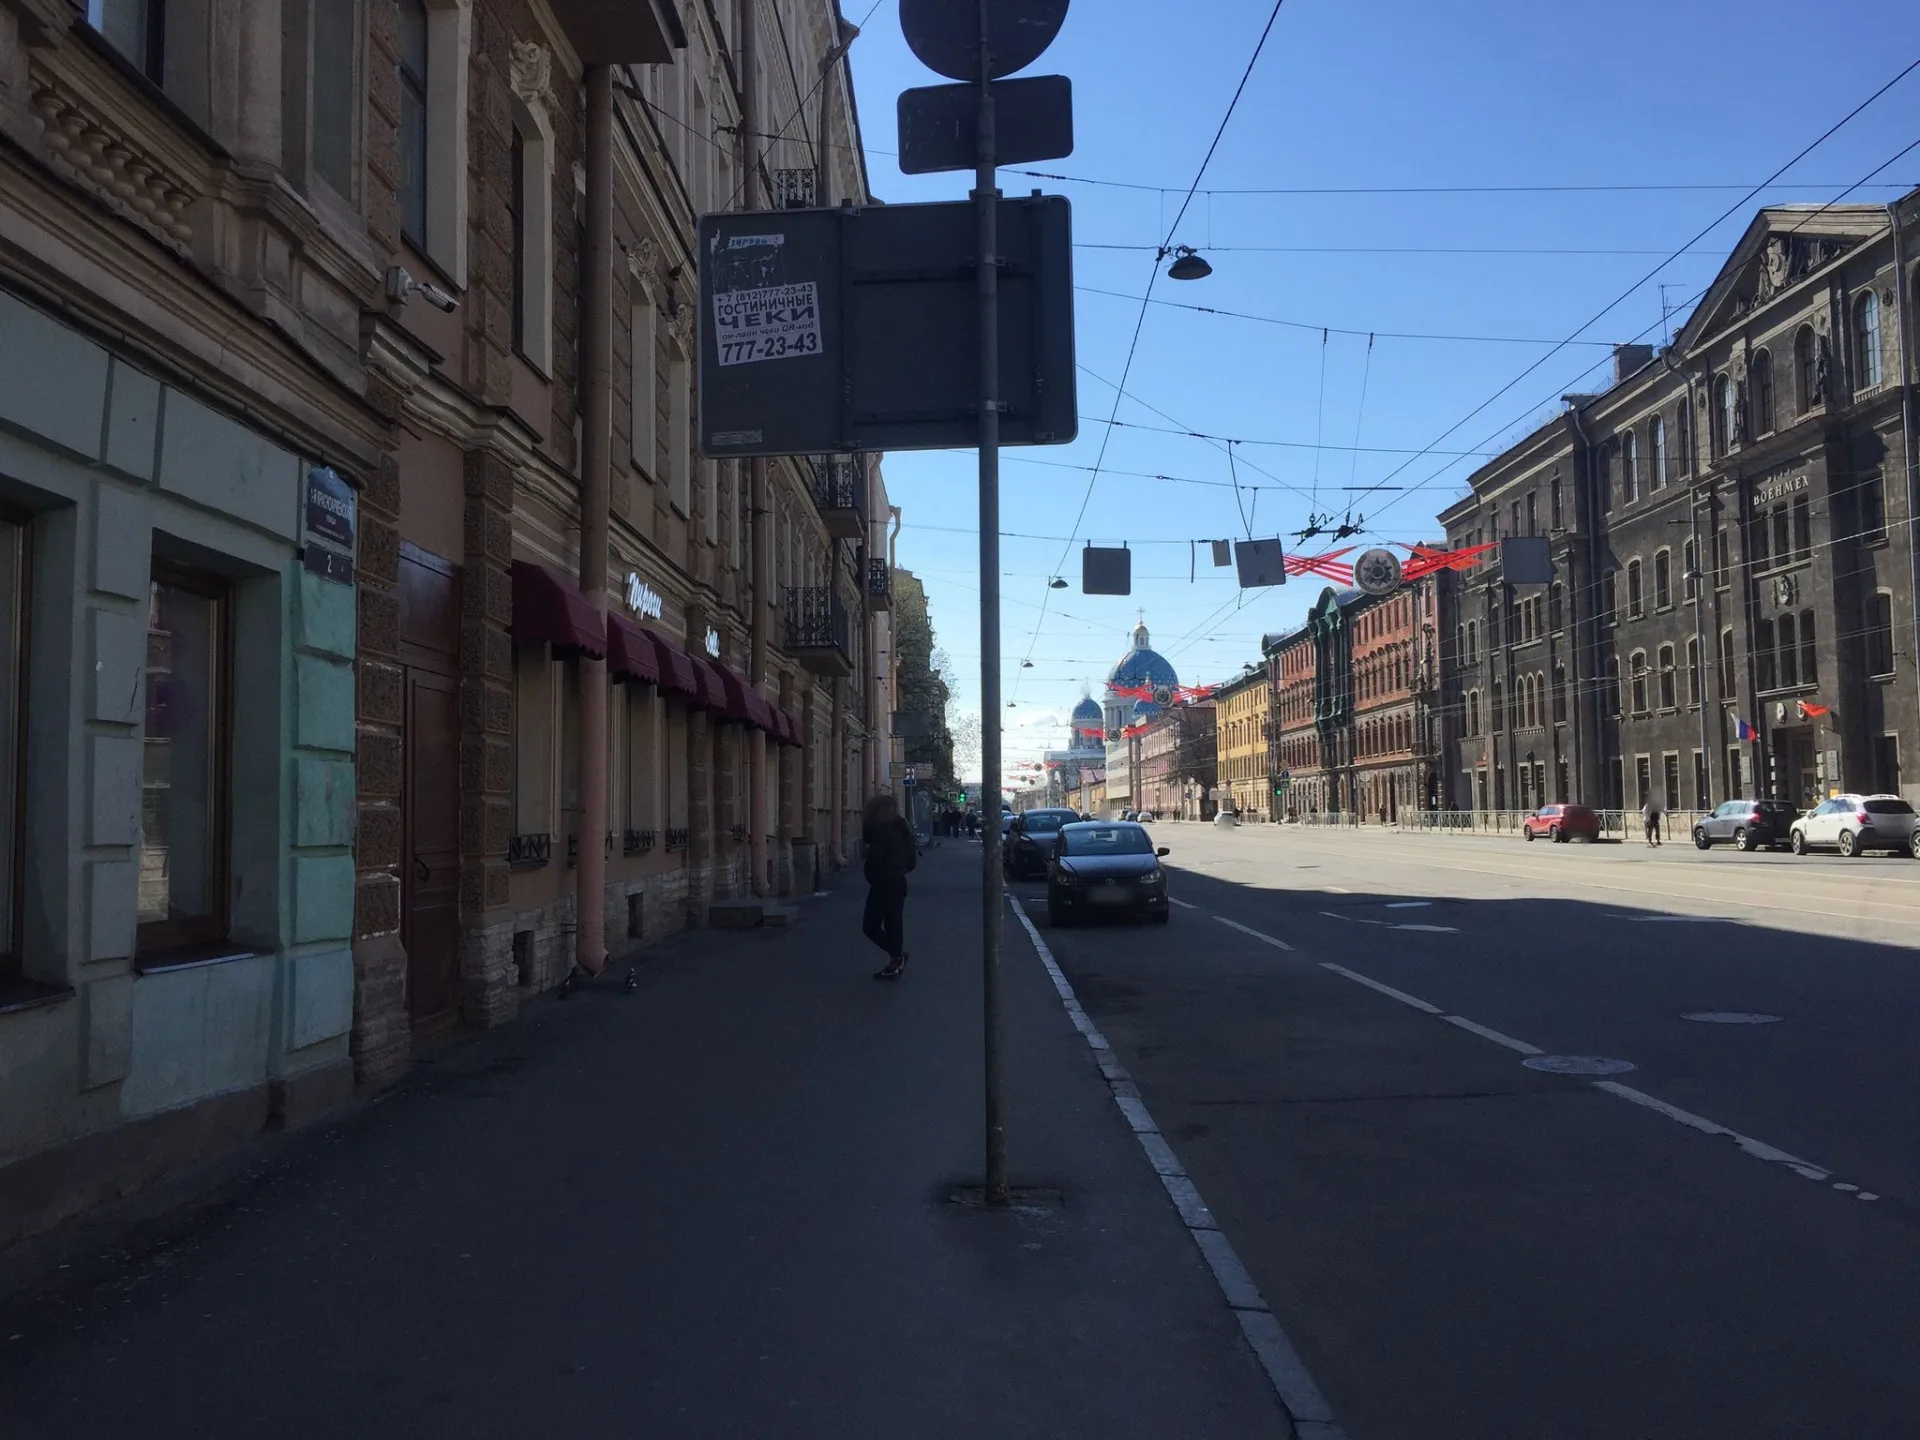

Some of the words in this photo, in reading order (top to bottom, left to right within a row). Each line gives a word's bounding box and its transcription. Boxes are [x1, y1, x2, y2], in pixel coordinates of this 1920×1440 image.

[718, 293, 813, 317] ГОСТИНИЧНЫЕ
[718, 307, 815, 329] ЧЕКИ
[782, 321, 814, 333] QR-код
[722, 332, 817, 363] 777-23-43
[327, 554, 332, 574] 2
